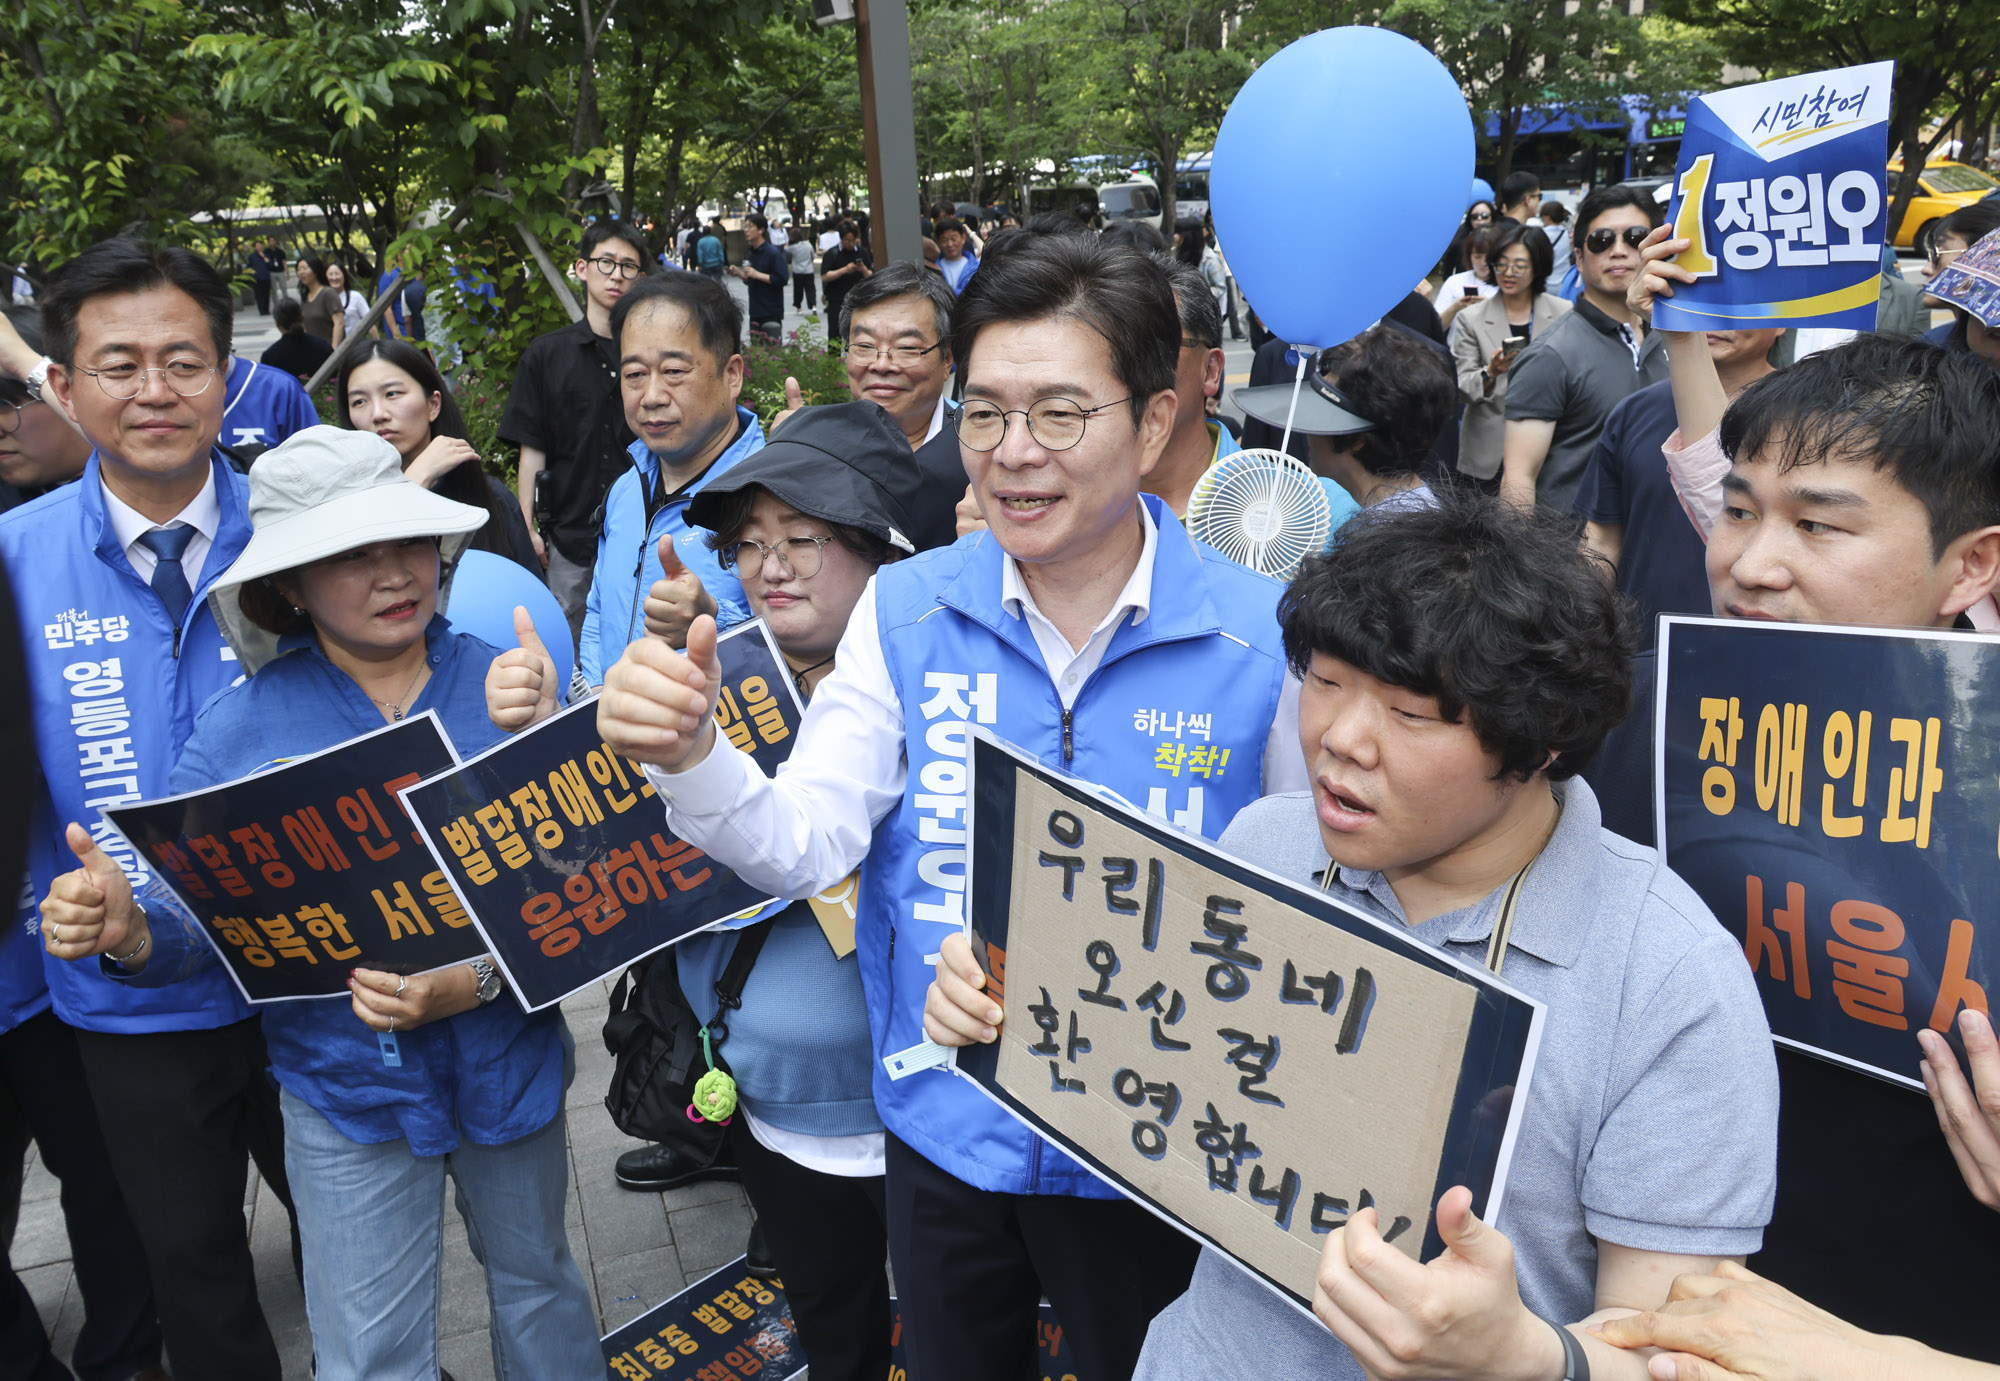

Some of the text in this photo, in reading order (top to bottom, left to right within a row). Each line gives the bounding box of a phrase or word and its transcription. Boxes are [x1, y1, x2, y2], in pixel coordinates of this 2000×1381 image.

[1752, 85, 1870, 134] 시민참여
[1671, 153, 1882, 277] 1 정원오
[44, 615, 130, 650] 민주당
[55, 608, 88, 624] 더불어
[1133, 708, 1212, 741] 하나씩
[1154, 742, 1231, 779] 착착!
[1698, 696, 1943, 849] 장애인과
[520, 832, 713, 958] 응원하는
[211, 902, 362, 968] 행복한
[1038, 809, 1377, 1055] 우리 동네
[1078, 939, 1191, 1051] 오신
